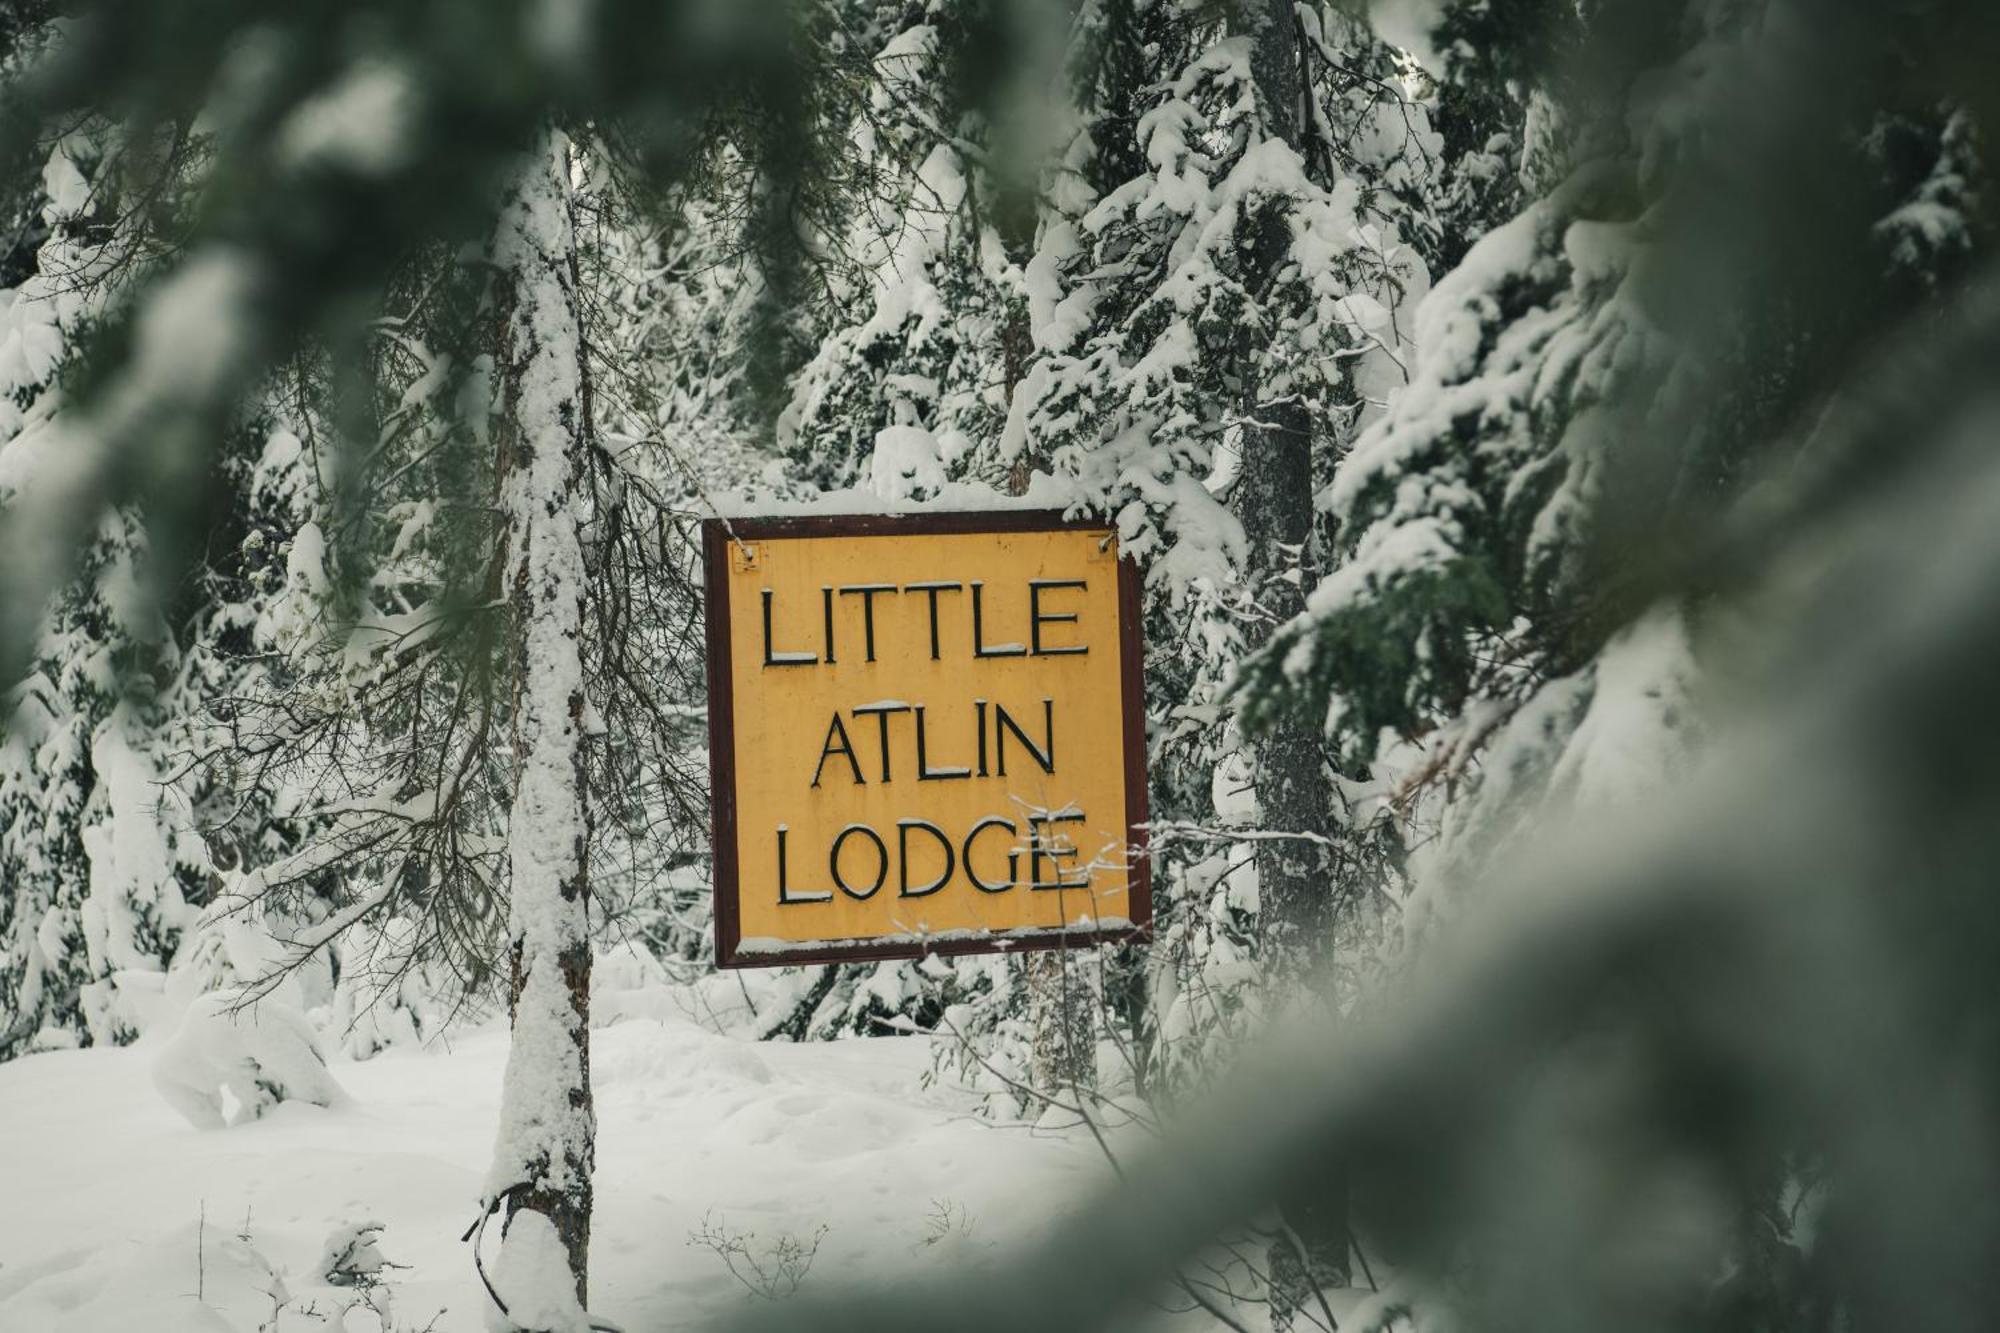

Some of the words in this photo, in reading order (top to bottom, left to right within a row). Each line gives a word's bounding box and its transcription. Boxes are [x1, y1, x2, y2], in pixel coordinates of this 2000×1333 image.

[761, 581, 1089, 667] LITTLE
[811, 700, 1055, 788] ATLIN
[777, 813, 1089, 904] LODGE
